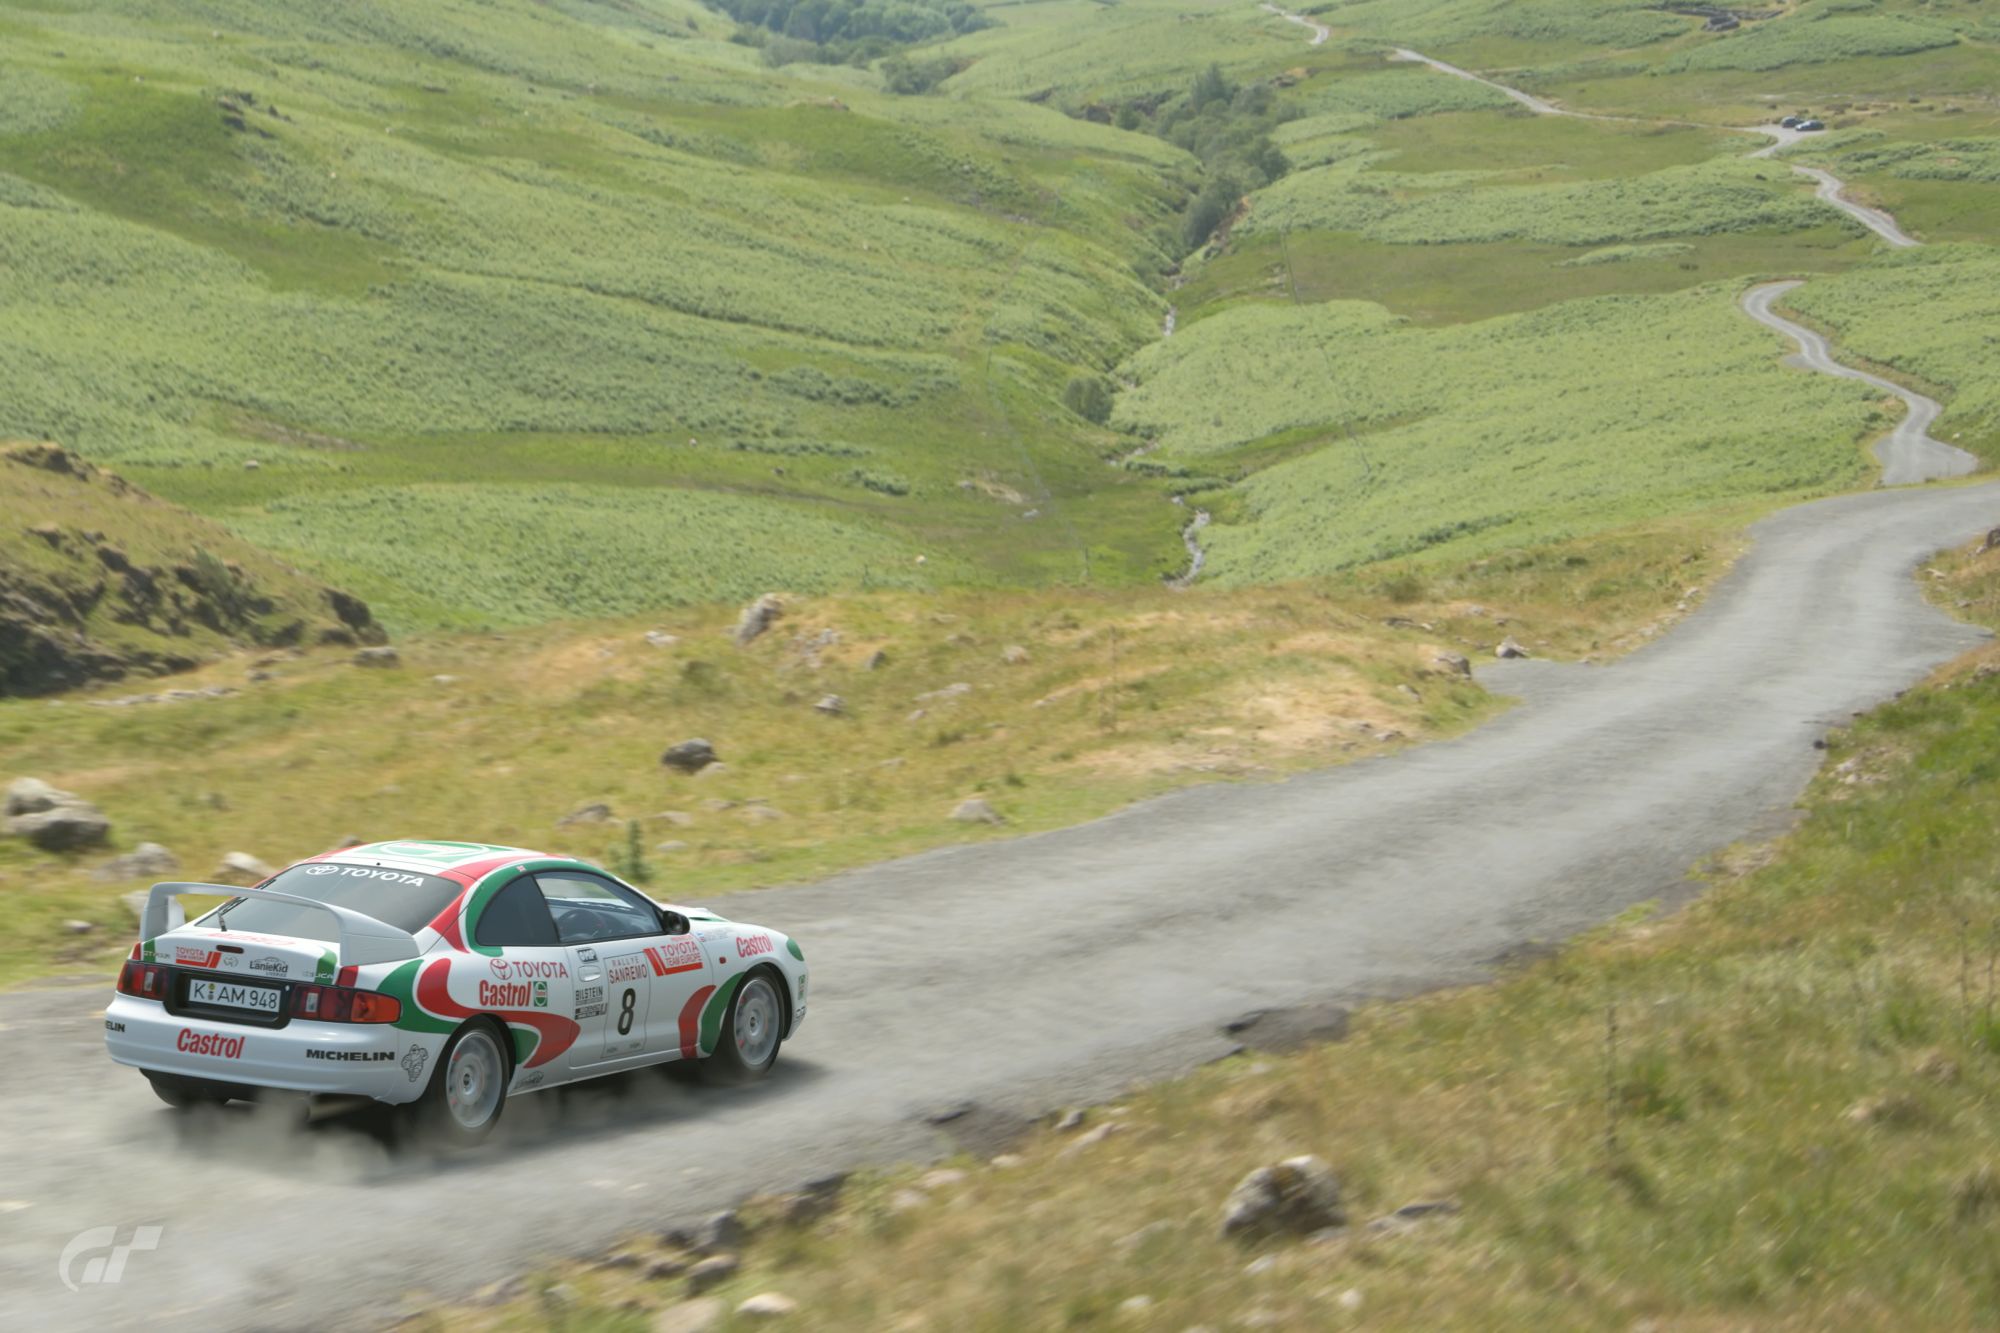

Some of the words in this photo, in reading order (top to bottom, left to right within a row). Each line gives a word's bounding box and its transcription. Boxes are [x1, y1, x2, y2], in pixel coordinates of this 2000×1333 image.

[339, 866, 424, 887] TOYOTA
[176, 946, 205, 956] TOYOTA
[660, 941, 699, 957] TOYOTA
[735, 933, 775, 958] Castrol
[249, 960, 288, 974] LanieKid
[512, 961, 569, 978] TOYOTA
[665, 955, 682, 967] TEAM
[608, 963, 648, 984] SANREMO
[249, 989, 278, 1009] 948
[479, 979, 532, 1007] Castrol
[575, 986, 604, 1001] BILSTEIN
[617, 987, 637, 1036] 8
[177, 1027, 246, 1060] Castrol
[306, 1049, 395, 1062] MICHELIN
